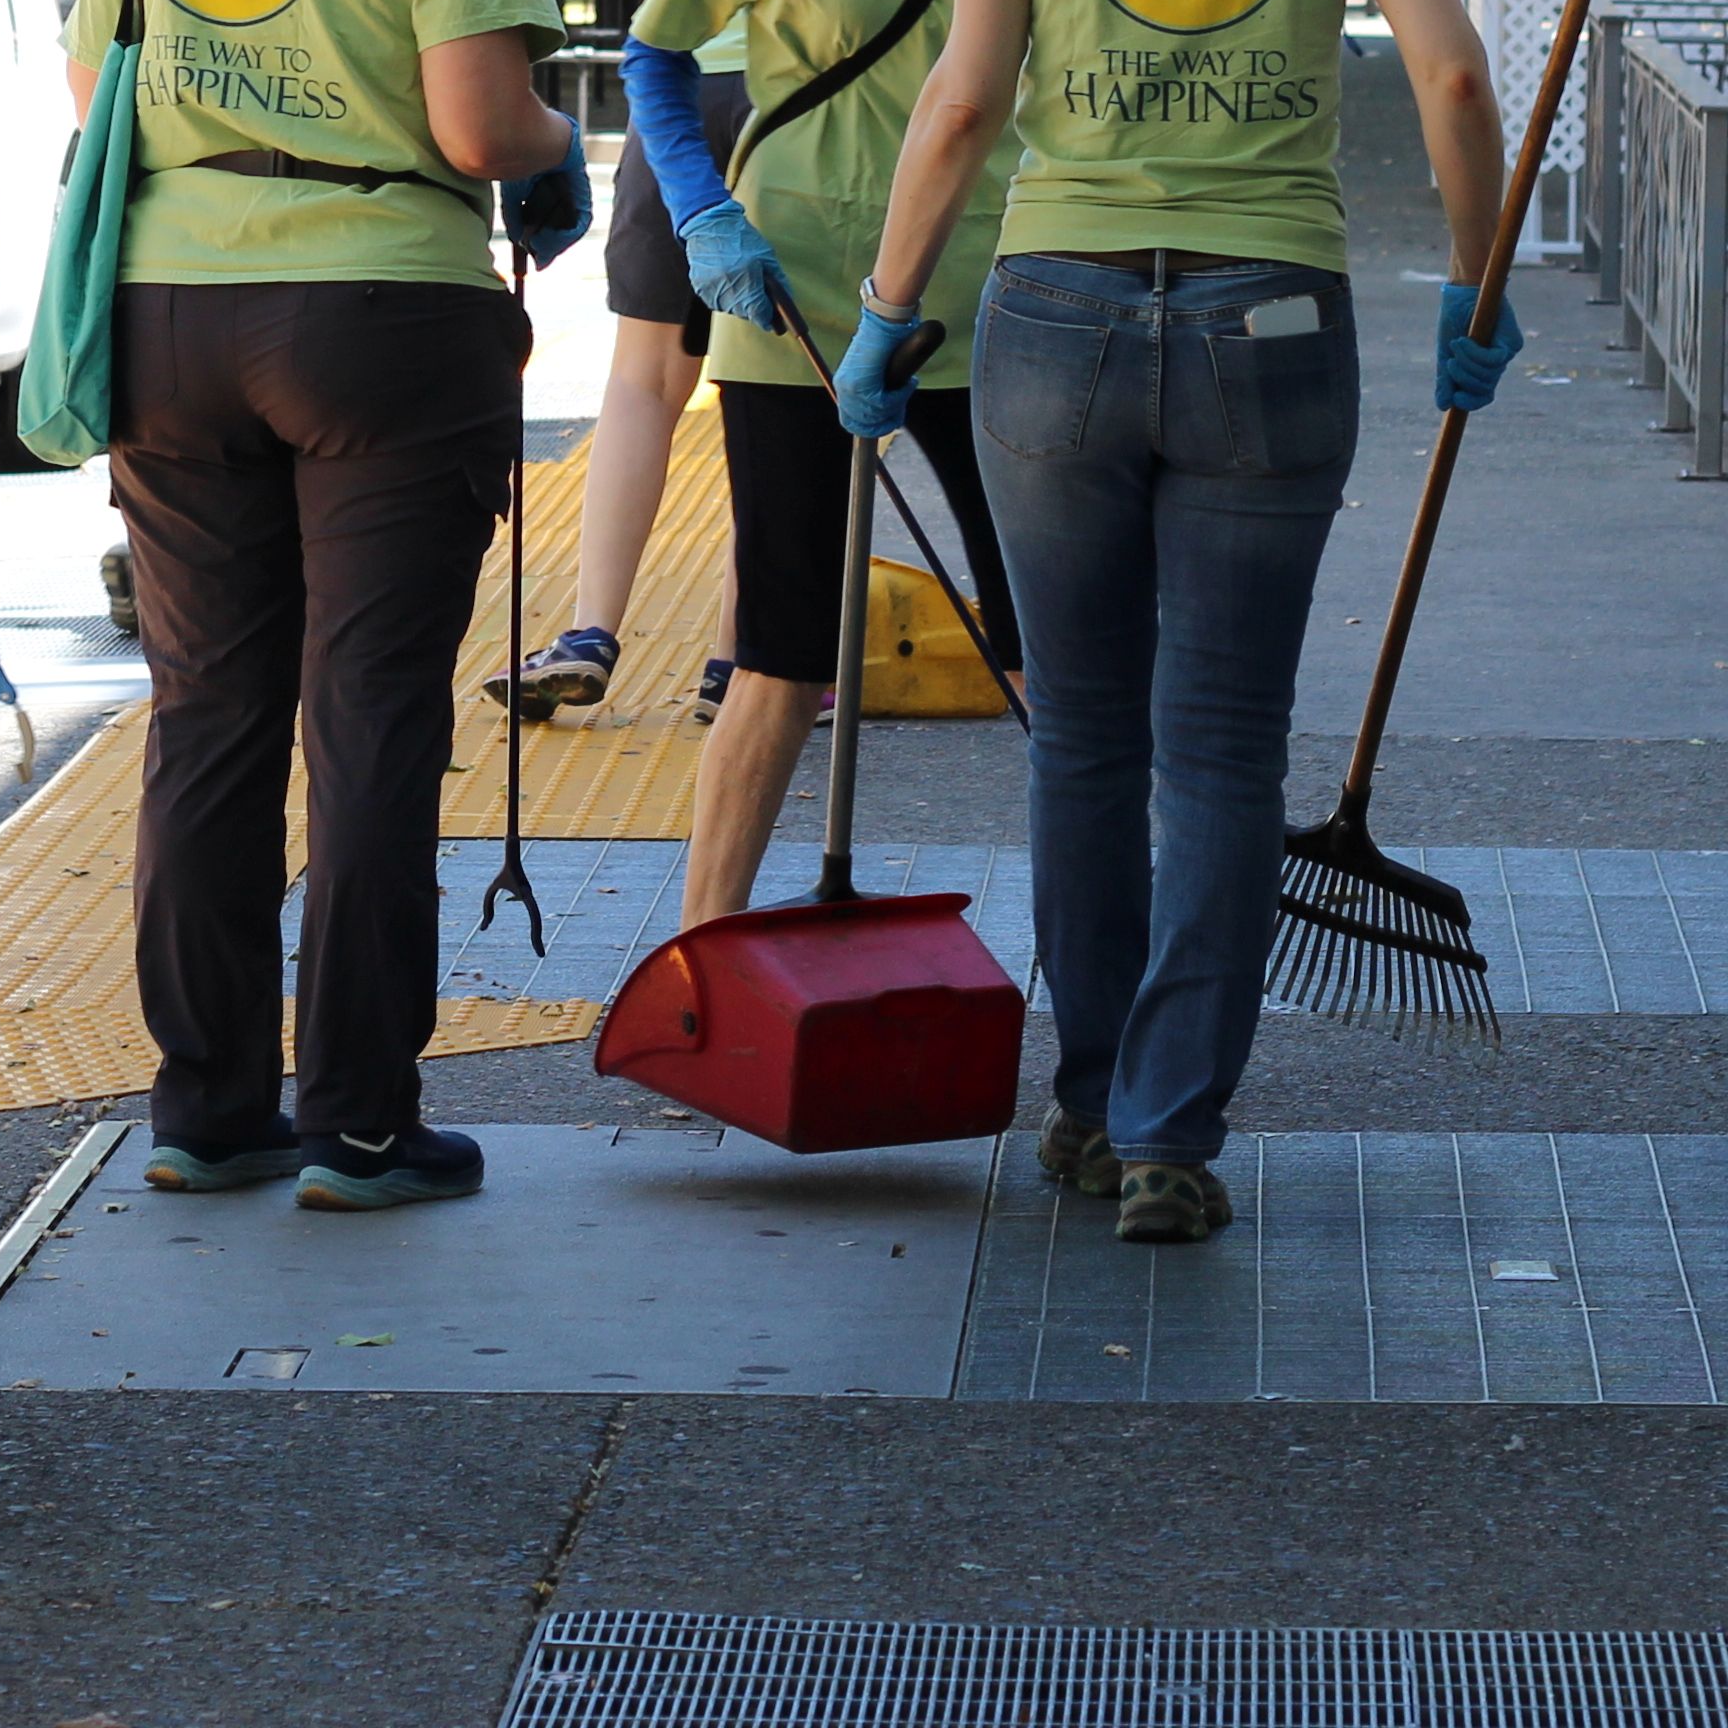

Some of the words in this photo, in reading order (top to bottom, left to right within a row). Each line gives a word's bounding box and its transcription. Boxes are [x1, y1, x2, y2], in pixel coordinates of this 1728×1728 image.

[152, 35, 198, 62] THE
[207, 40, 266, 69] WAY
[274, 46, 312, 73] TO
[1100, 49, 1162, 77] THE
[1171, 50, 1235, 76] WAY
[1244, 50, 1288, 76] TO
[137, 60, 348, 121] HAPPINESS
[1064, 69, 1320, 123] HAPPINESS
